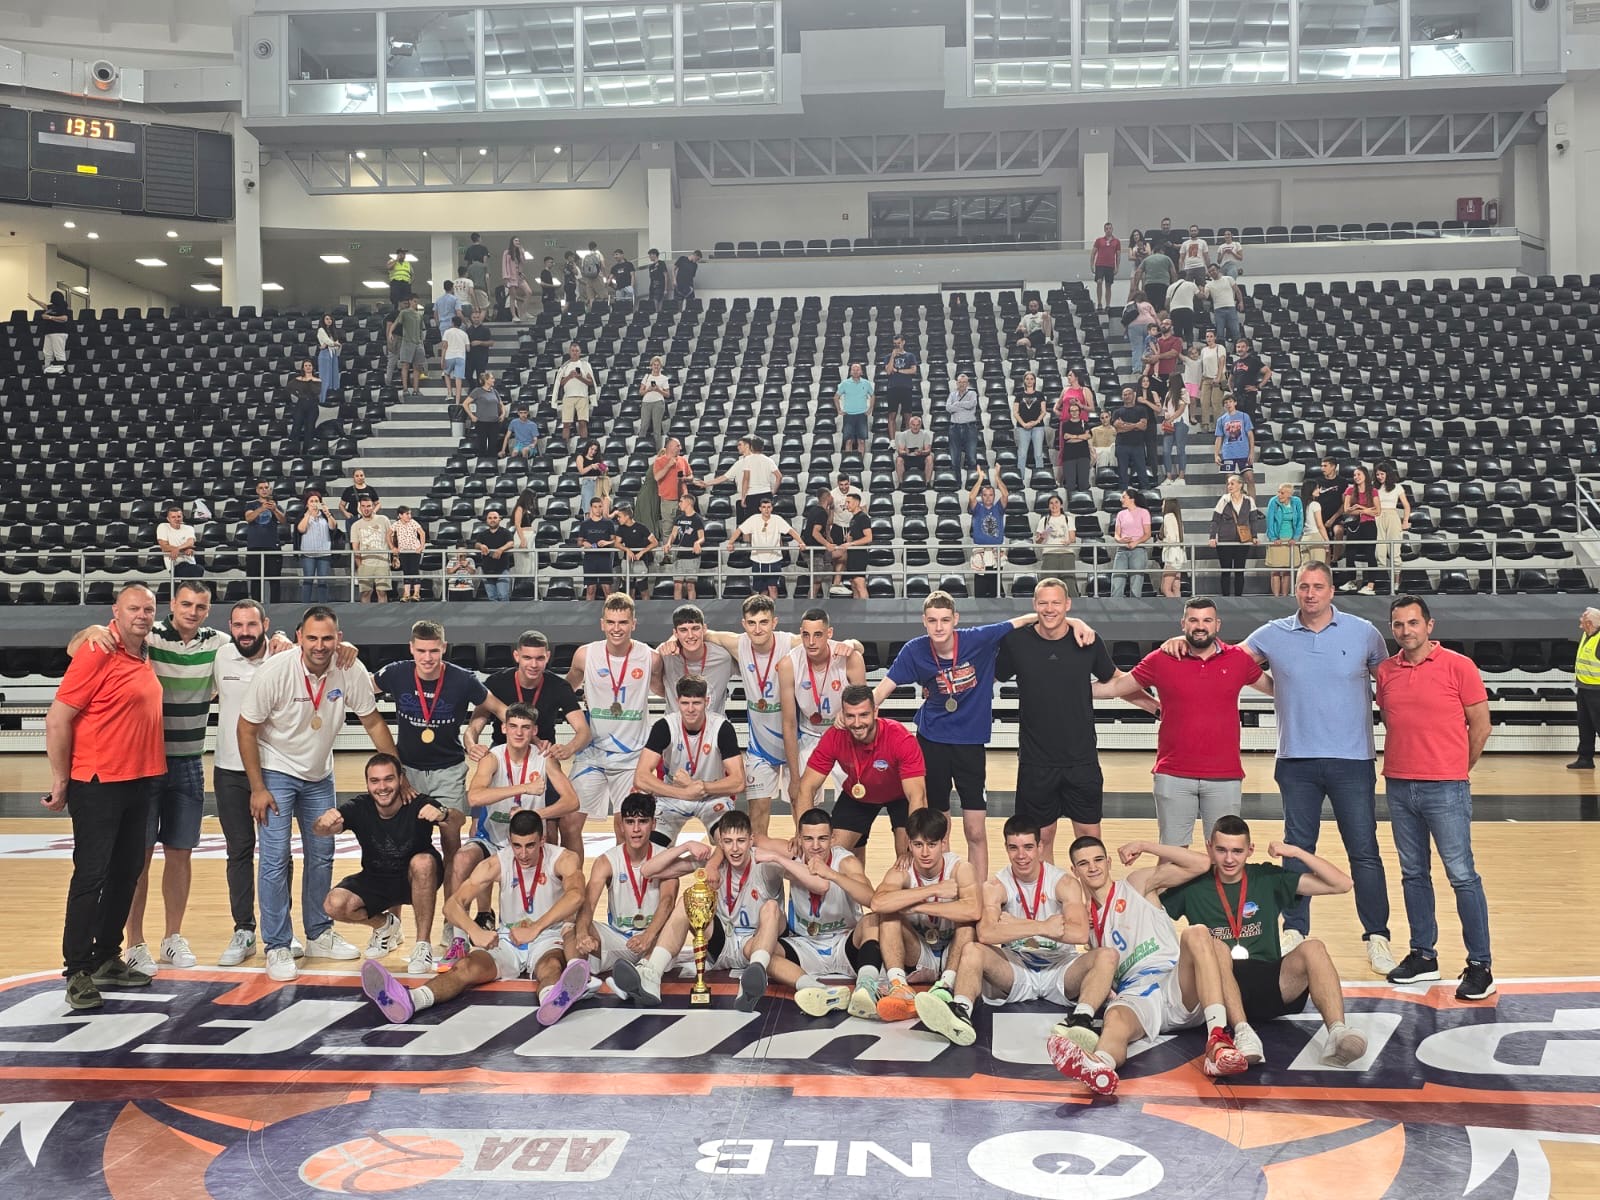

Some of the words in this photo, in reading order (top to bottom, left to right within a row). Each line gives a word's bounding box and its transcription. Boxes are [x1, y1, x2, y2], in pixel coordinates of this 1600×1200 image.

[66, 118, 114, 138] 19:57
[1111, 930, 1127, 951] 9
[473, 1135, 616, 1173] ABA
[694, 1138, 932, 1178] NLB
